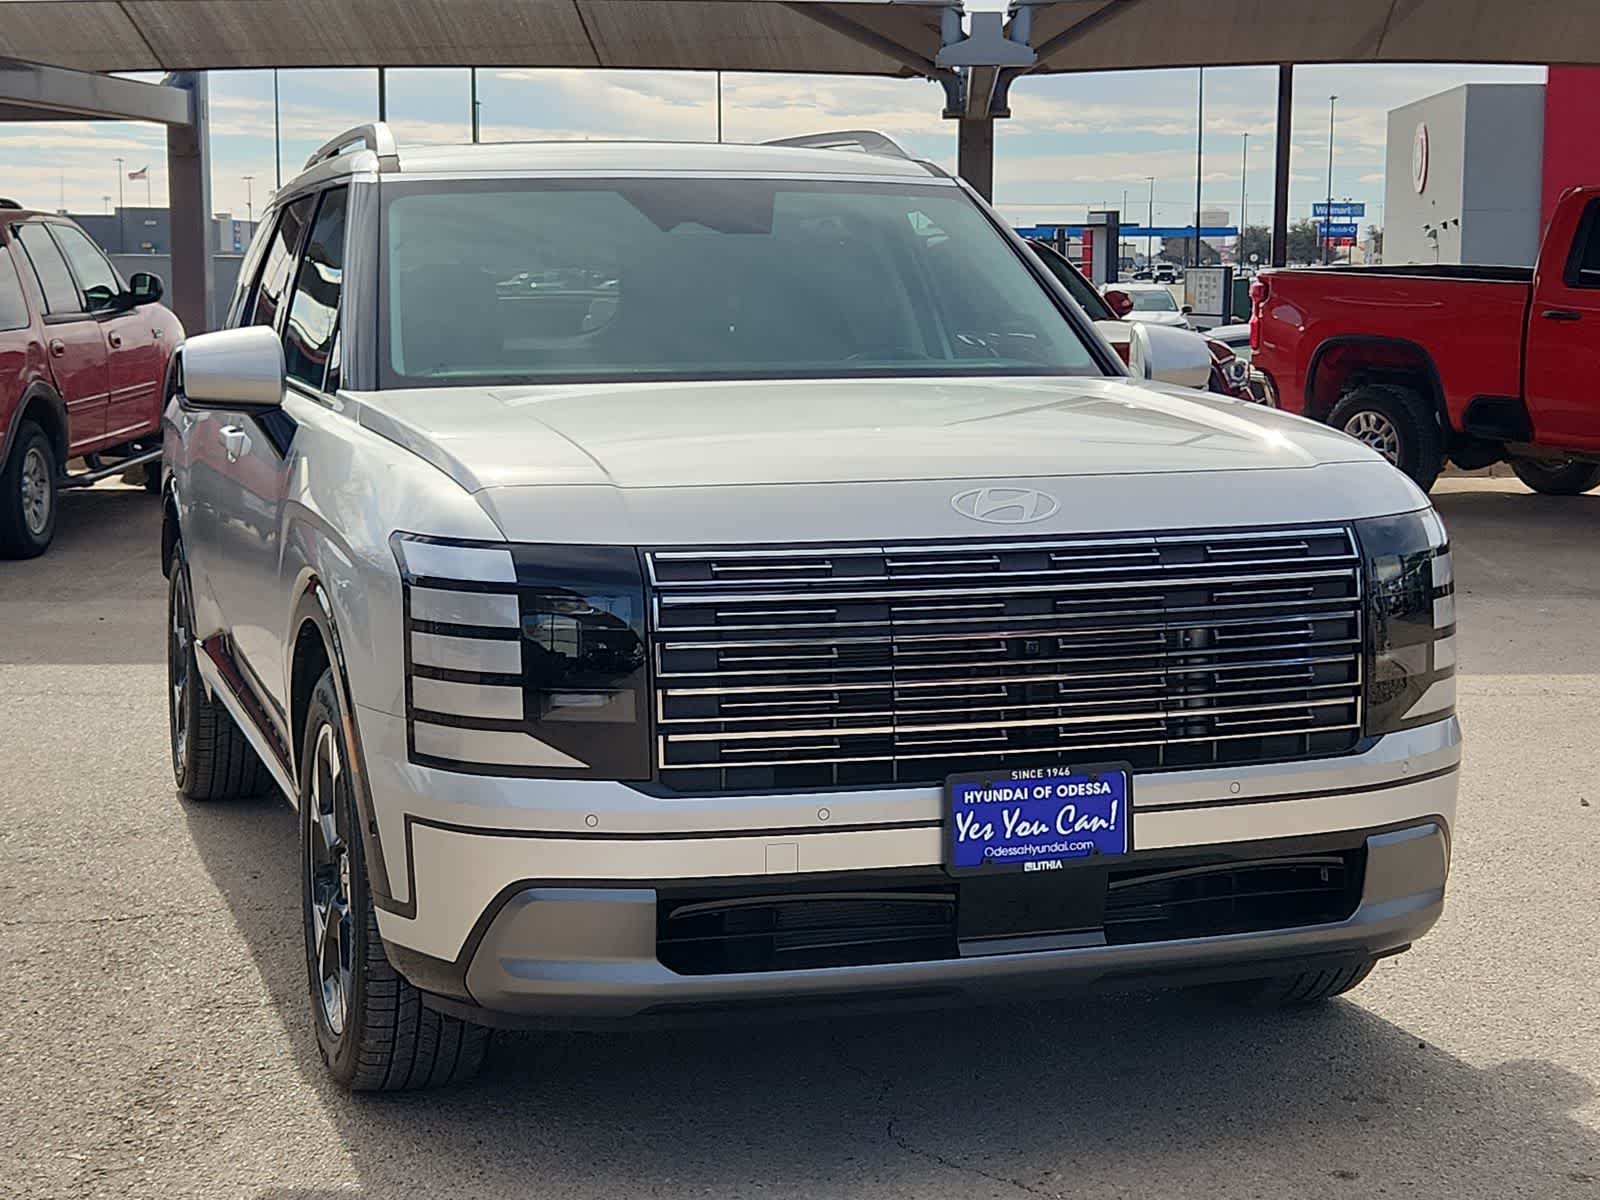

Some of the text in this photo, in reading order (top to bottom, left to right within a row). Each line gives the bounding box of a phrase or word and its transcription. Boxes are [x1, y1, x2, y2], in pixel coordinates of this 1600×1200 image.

[1011, 767, 1071, 780] SINCE 1946
[964, 782, 1111, 804] HYUNDAI OF ODESSA
[955, 799, 1118, 842] Yes You Can!
[984, 841, 1094, 858] OdessaHyundai.com
[1032, 859, 1064, 871] LITHIA
